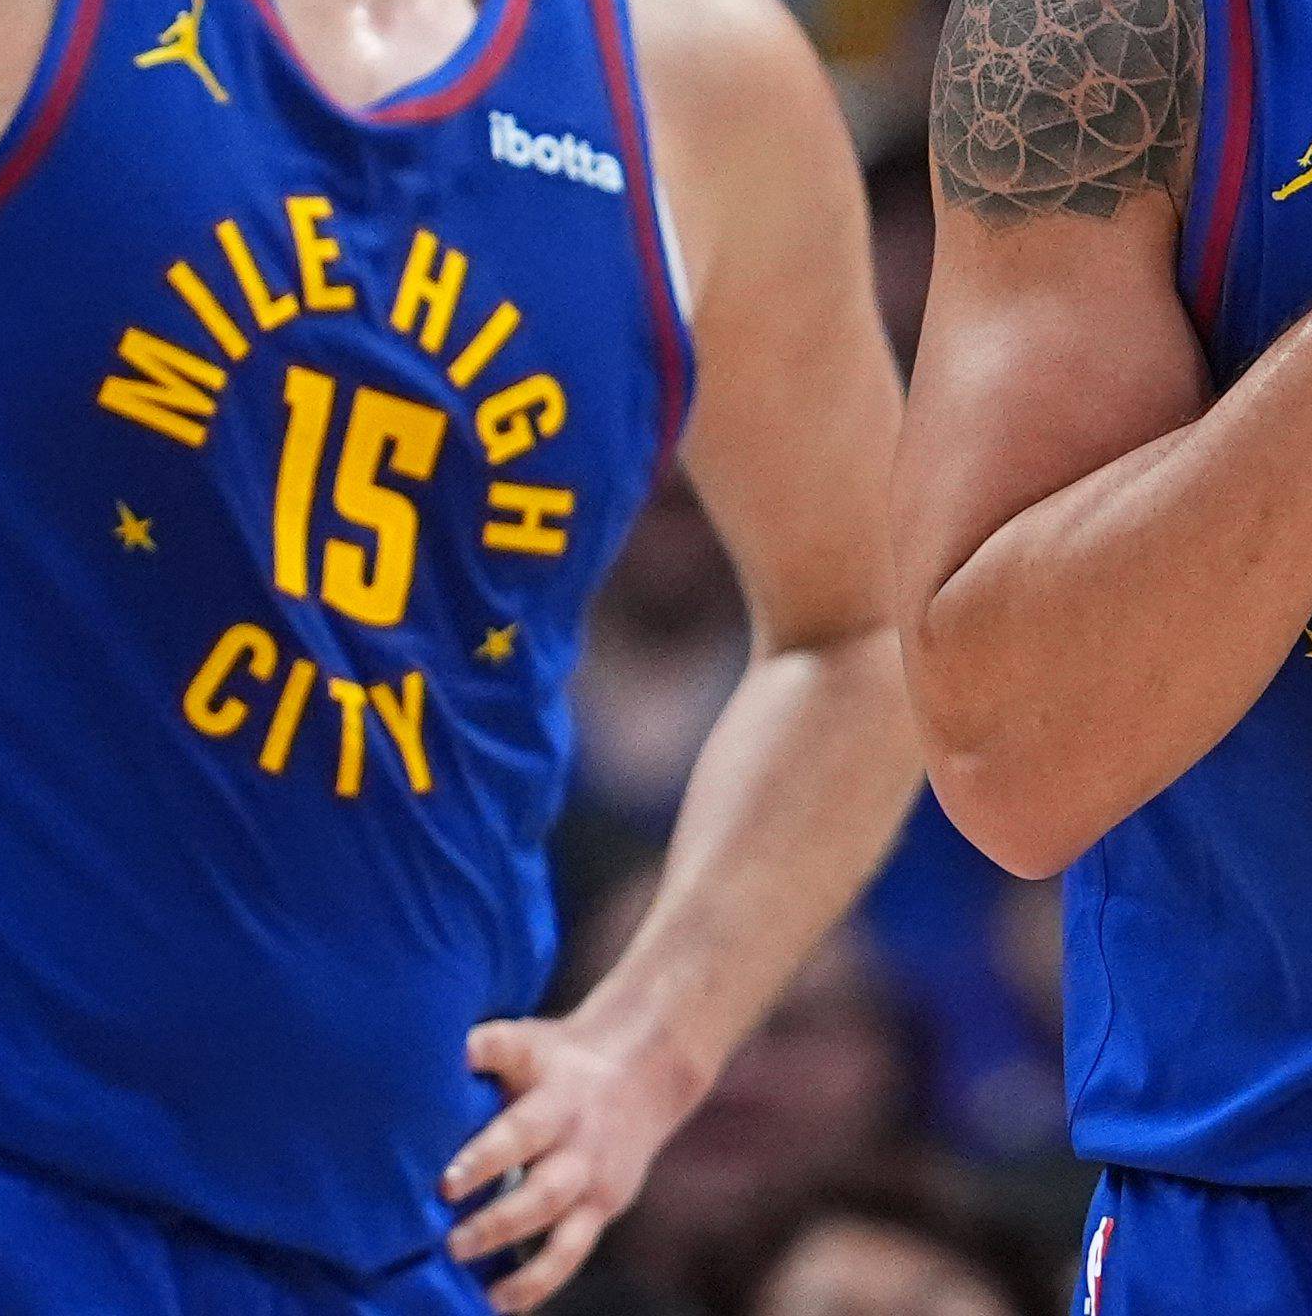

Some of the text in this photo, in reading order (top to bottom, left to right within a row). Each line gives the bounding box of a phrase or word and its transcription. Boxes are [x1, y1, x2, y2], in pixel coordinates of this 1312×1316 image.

[489, 110, 625, 194] ibotta
[98, 195, 576, 556] MILE HIGH
[273, 365, 448, 626] 15
[182, 622, 433, 798] CITY
